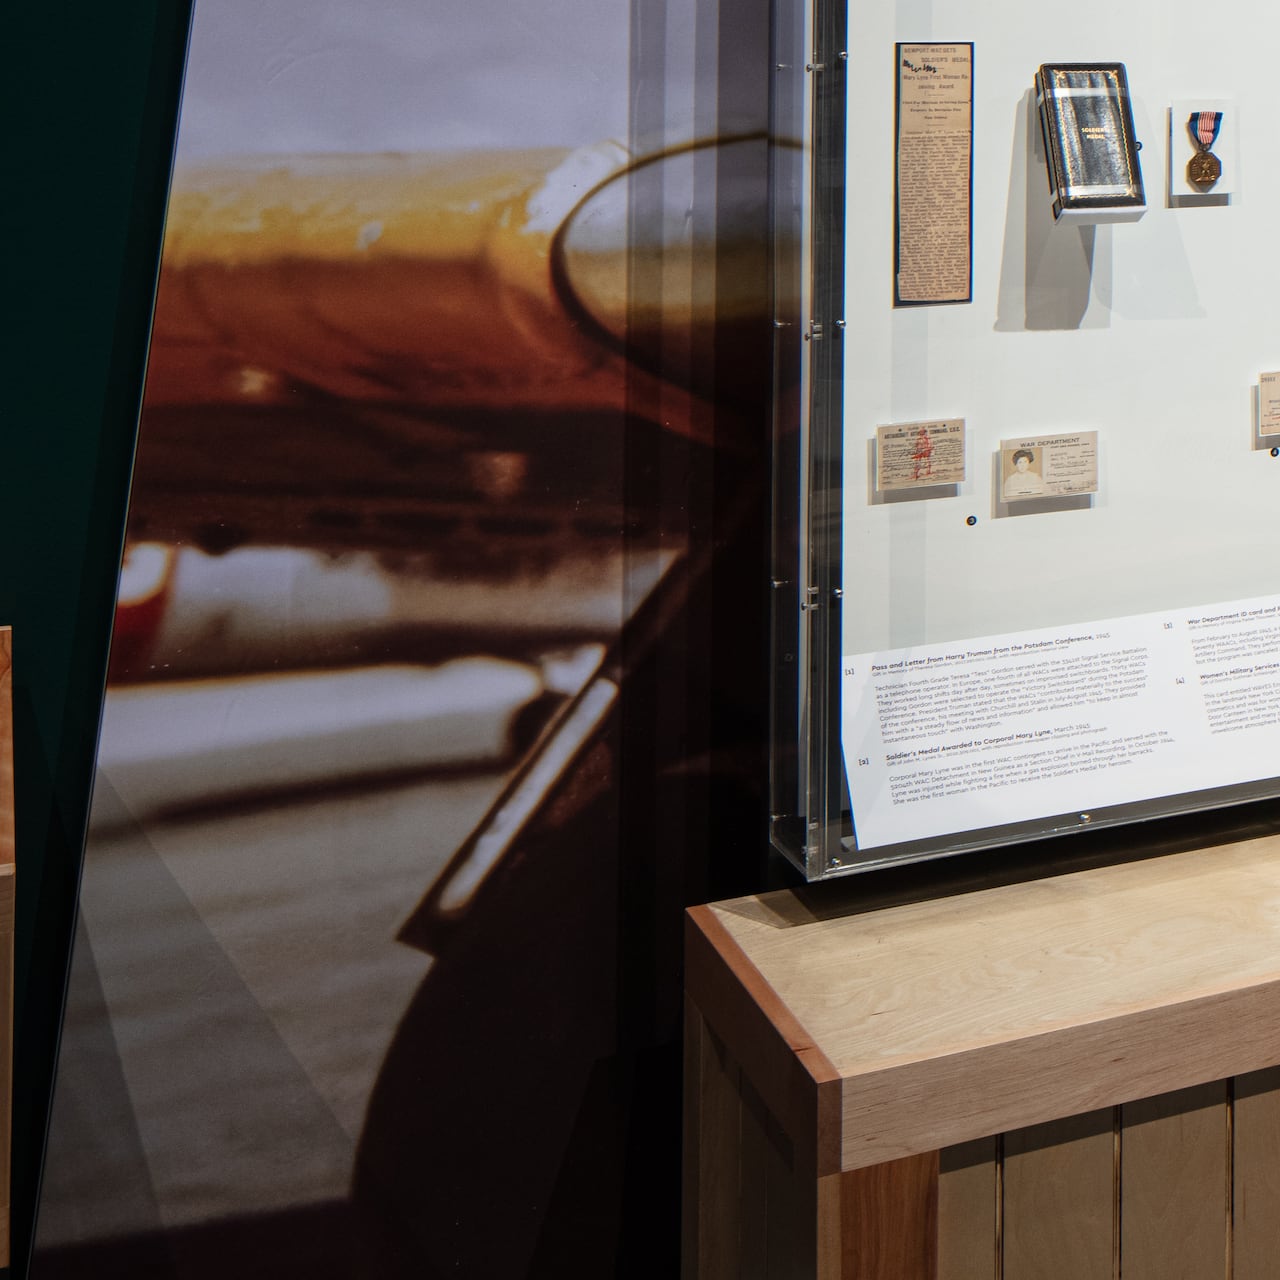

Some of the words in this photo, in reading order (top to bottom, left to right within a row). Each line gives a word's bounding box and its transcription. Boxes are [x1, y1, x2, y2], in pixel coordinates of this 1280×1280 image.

[1037, 437, 1080, 447] DEPARTMENT
[1202, 612, 1238, 623] Department
[926, 656, 943, 665] from
[967, 649, 991, 657] Truman
[993, 647, 1009, 655] from
[1024, 640, 1053, 649] Potsdam
[1055, 635, 1093, 644] Conference,
[1200, 670, 1227, 679] Women's
[1255, 662, 1279, 670] Services
[886, 750, 915, 760] Soldier's
[918, 746, 939, 754] Medal
[941, 740, 972, 751] Awarded
[984, 734, 1014, 744] Corporal
[1035, 729, 1052, 737] Lyne,
[1054, 724, 1074, 733] March
